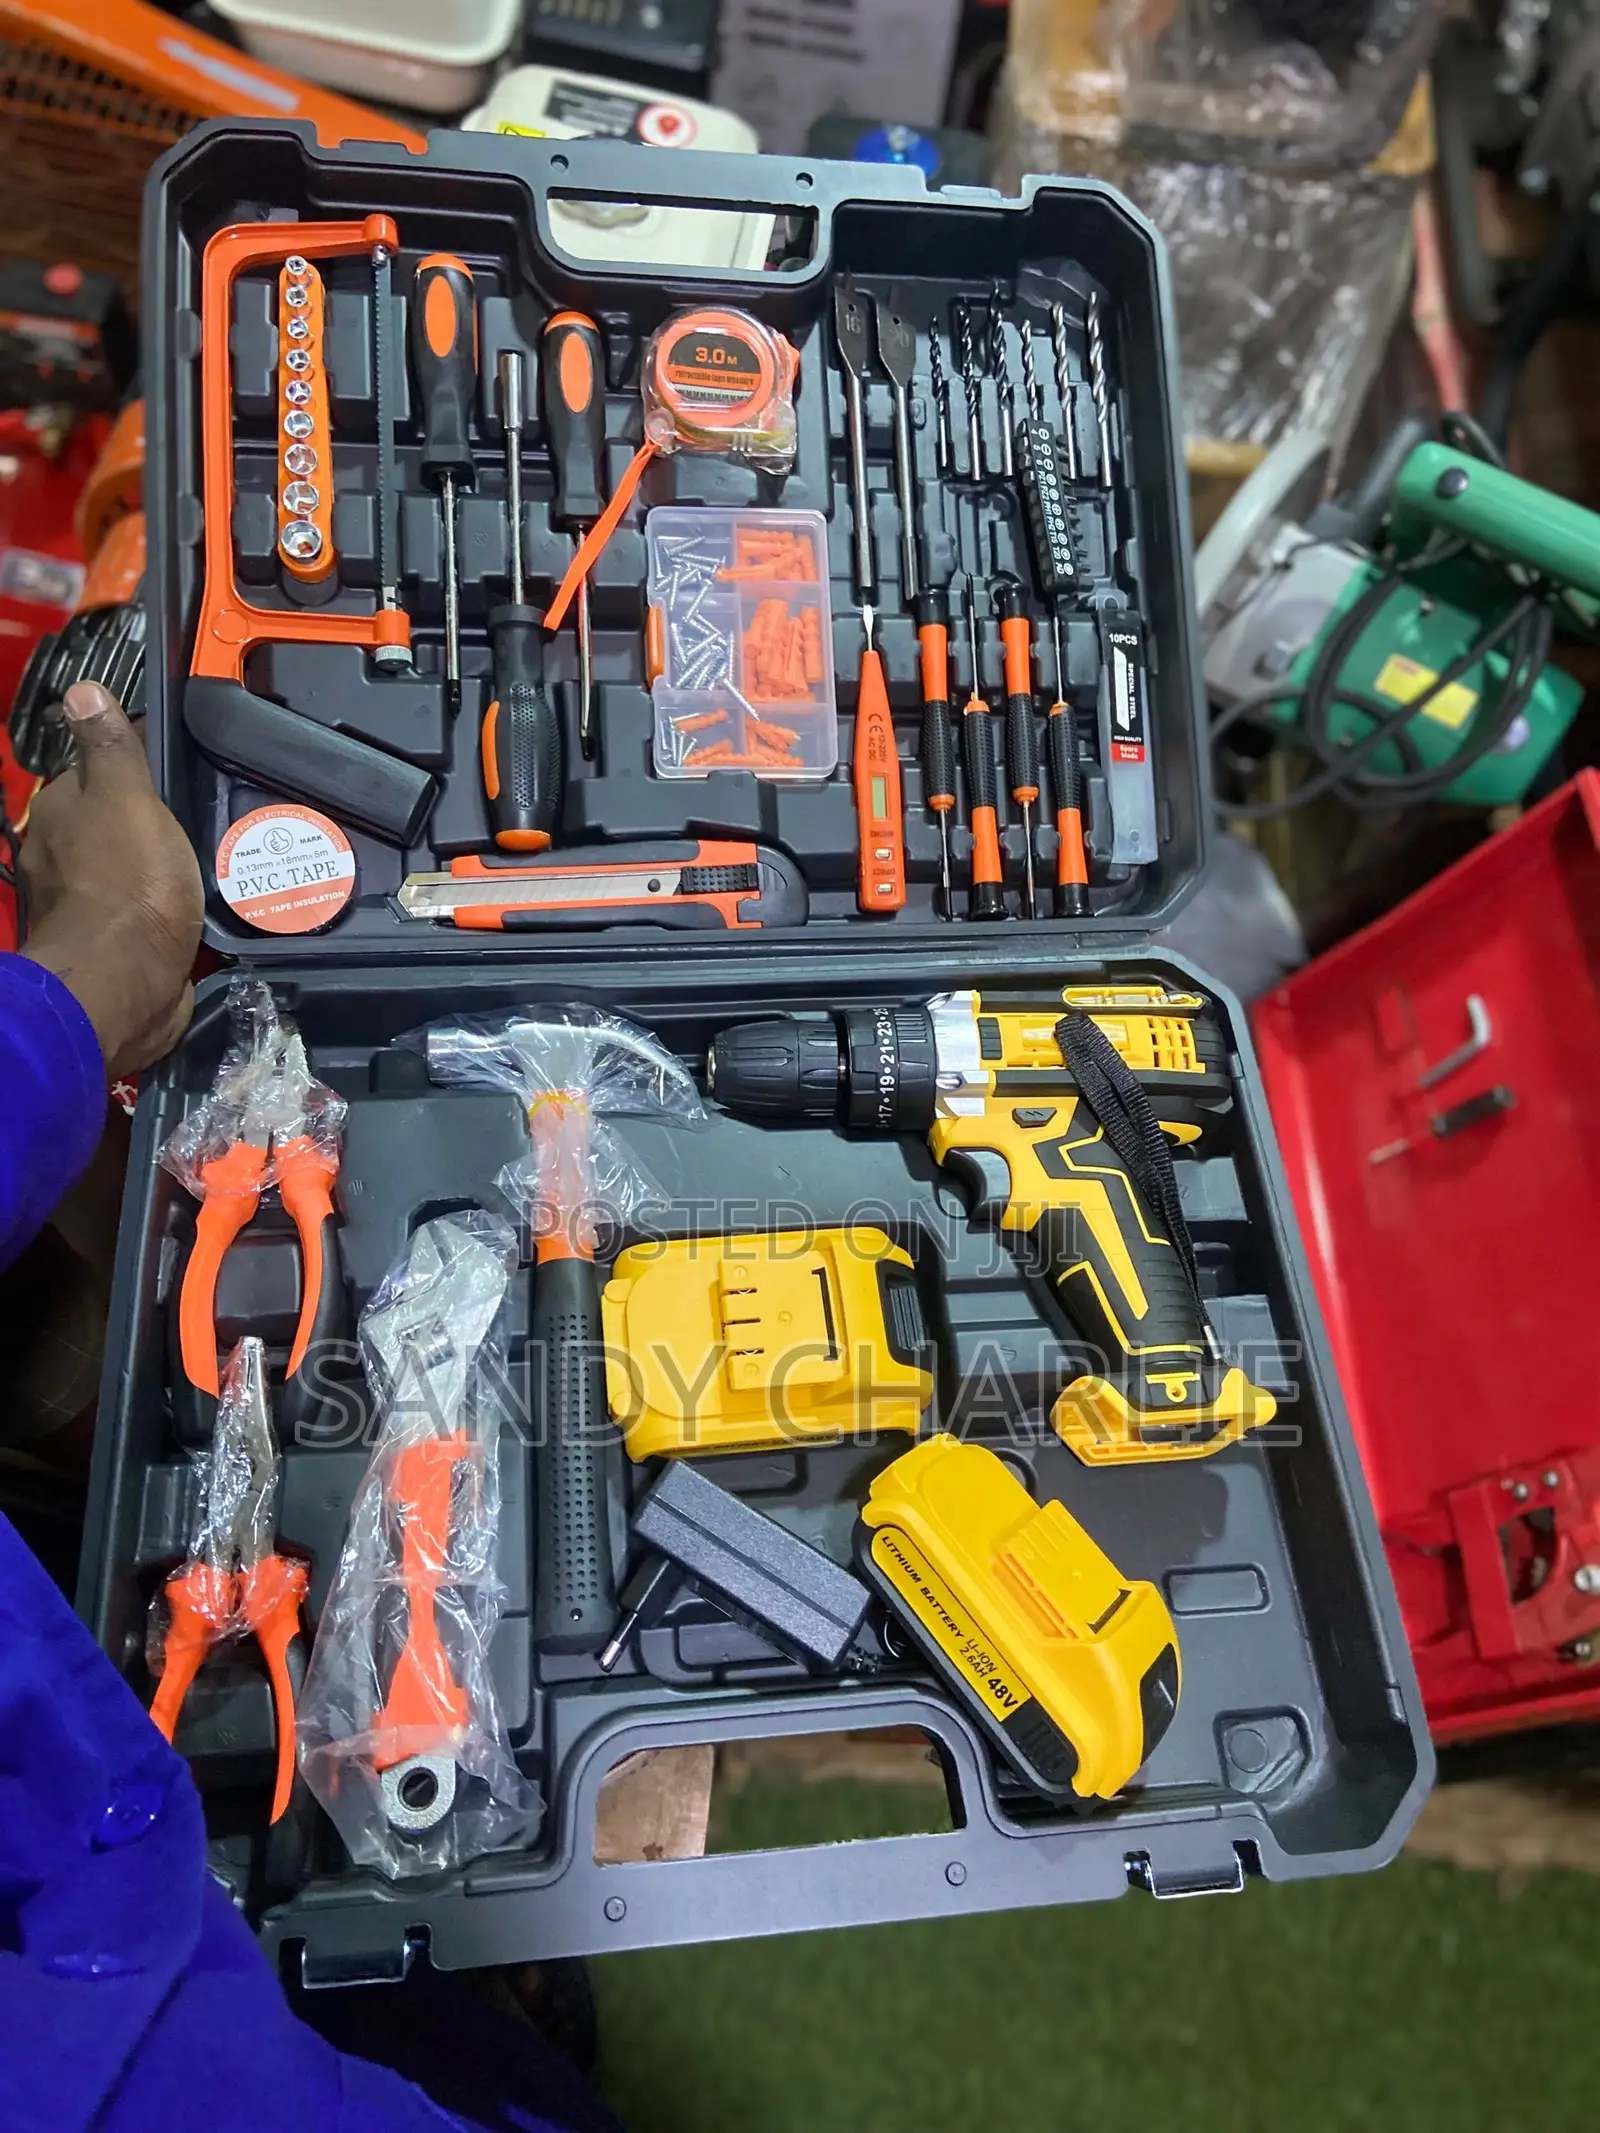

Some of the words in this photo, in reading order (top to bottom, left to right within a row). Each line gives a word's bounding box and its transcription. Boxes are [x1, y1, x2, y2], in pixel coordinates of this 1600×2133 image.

[1108, 633, 1138, 645] 10PCS
[1127, 662, 1135, 694] SPECIAL
[239, 820, 254, 833] FOR
[255, 810, 305, 822] ELECTRICAL
[307, 815, 344, 852] INSULATION
[235, 847, 262, 859] TRADE
[300, 834, 323, 845] MARK
[237, 872, 286, 898] P.V.C.
[287, 860, 340, 886] TAPE
[269, 902, 292, 914] TAPE
[293, 890, 346, 909] INSULATION
[876, 1021, 893, 1036] 23
[880, 1046, 895, 1065] 21
[880, 1075, 895, 1094] 19
[878, 1104, 893, 1119] 17
[882, 1535, 922, 1583] LITHIUM
[920, 1587, 965, 1639] BATTERY
[959, 1647, 988, 1678] 2.6AH
[966, 1638, 999, 1673] LI-ION
[987, 1677, 1019, 1709] 48V
